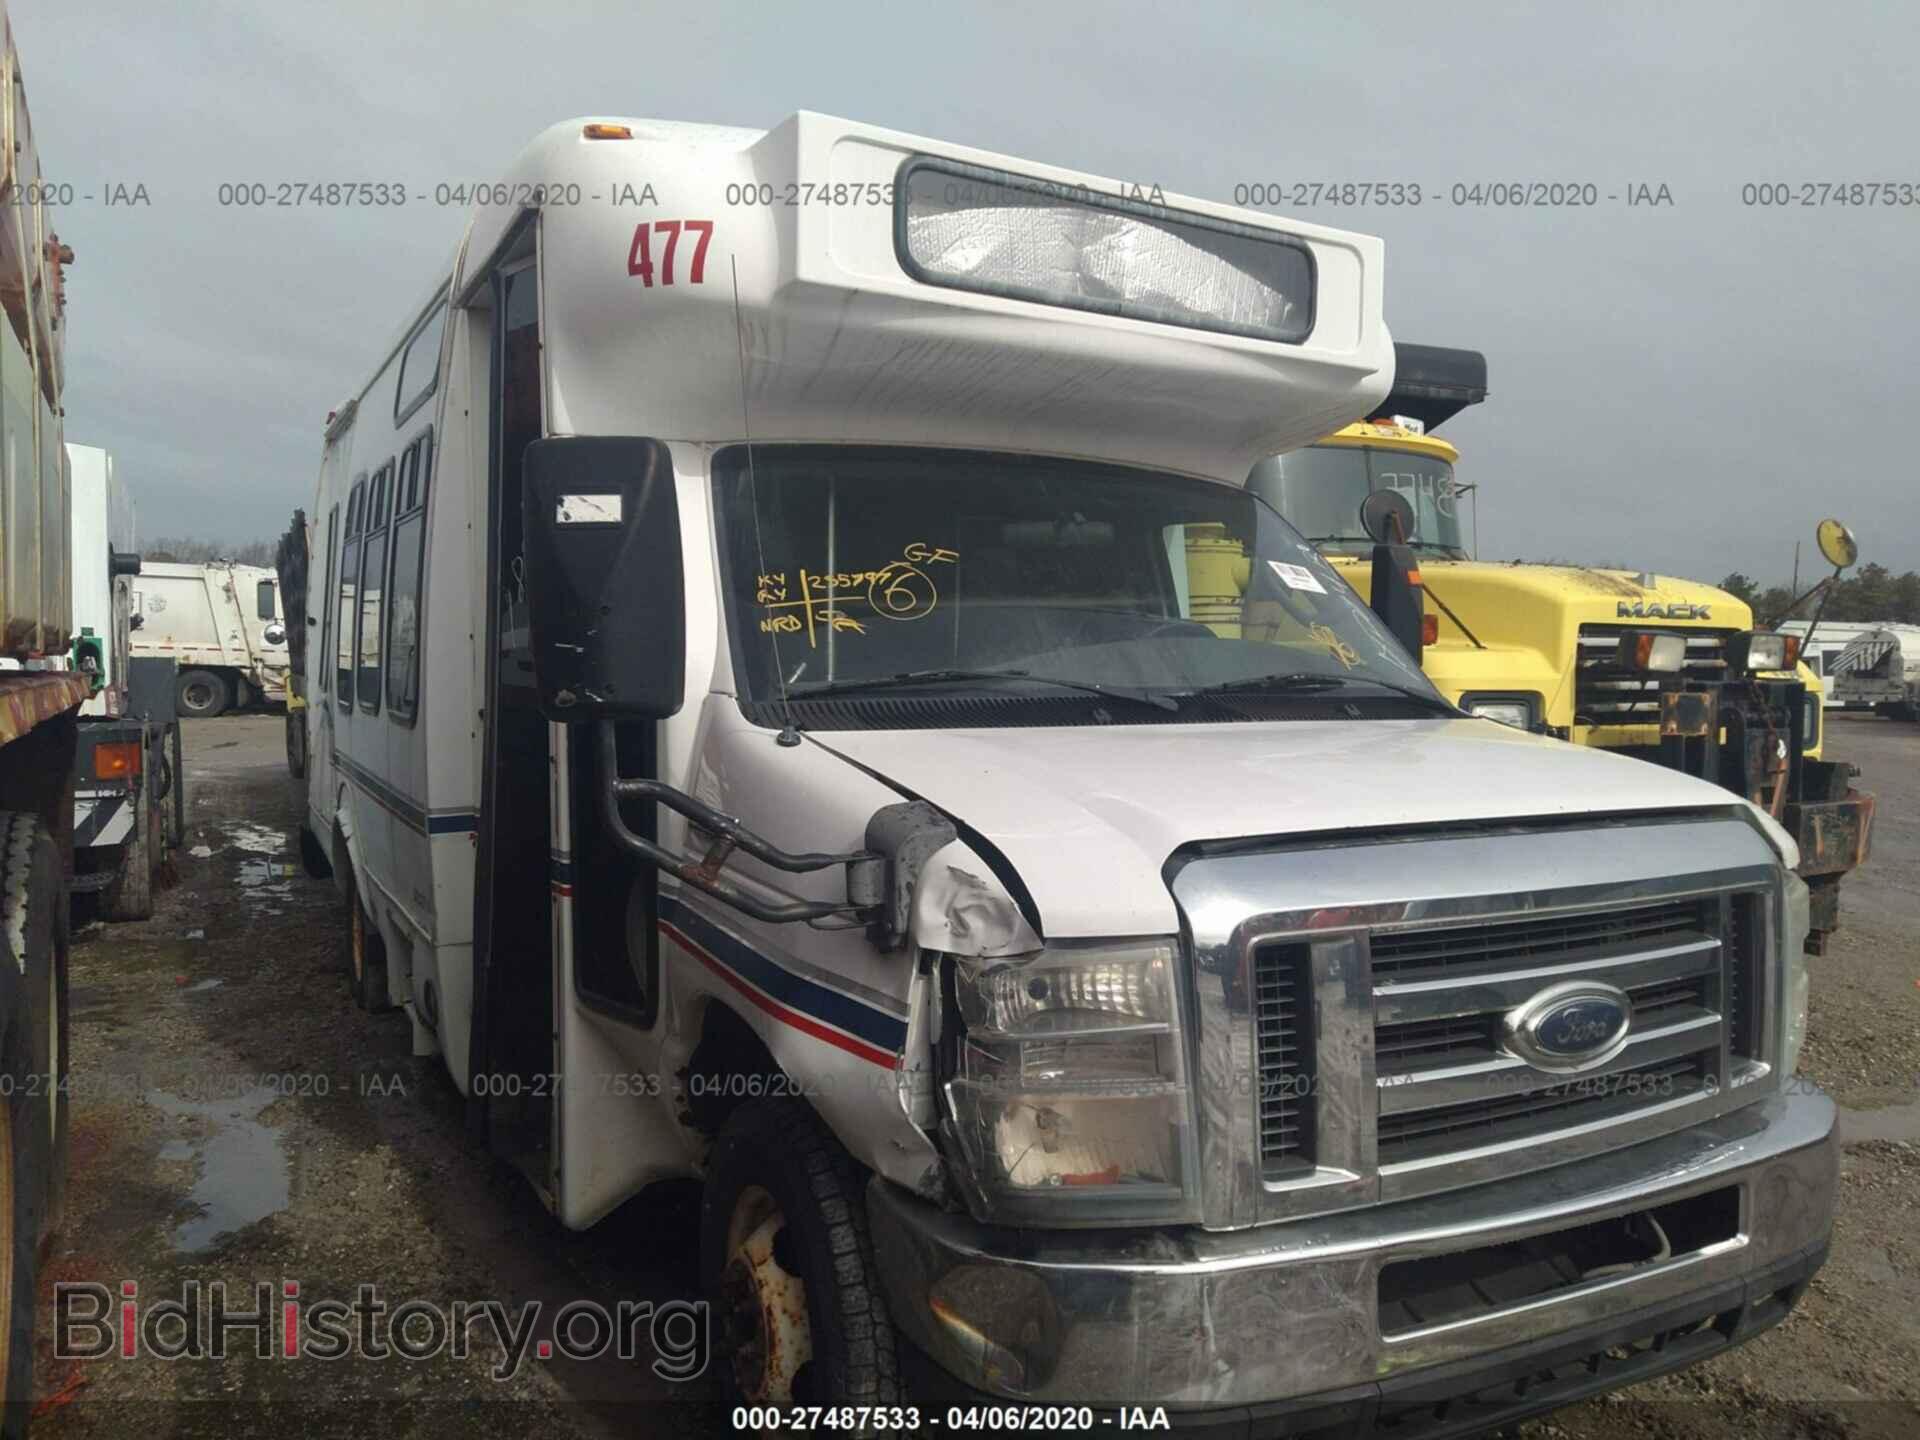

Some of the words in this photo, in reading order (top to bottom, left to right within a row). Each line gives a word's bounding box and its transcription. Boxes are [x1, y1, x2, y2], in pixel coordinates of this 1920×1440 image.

[628, 220, 714, 288] 477
[1616, 600, 1712, 620] MACK
[1556, 1008, 1608, 1044] Ford
